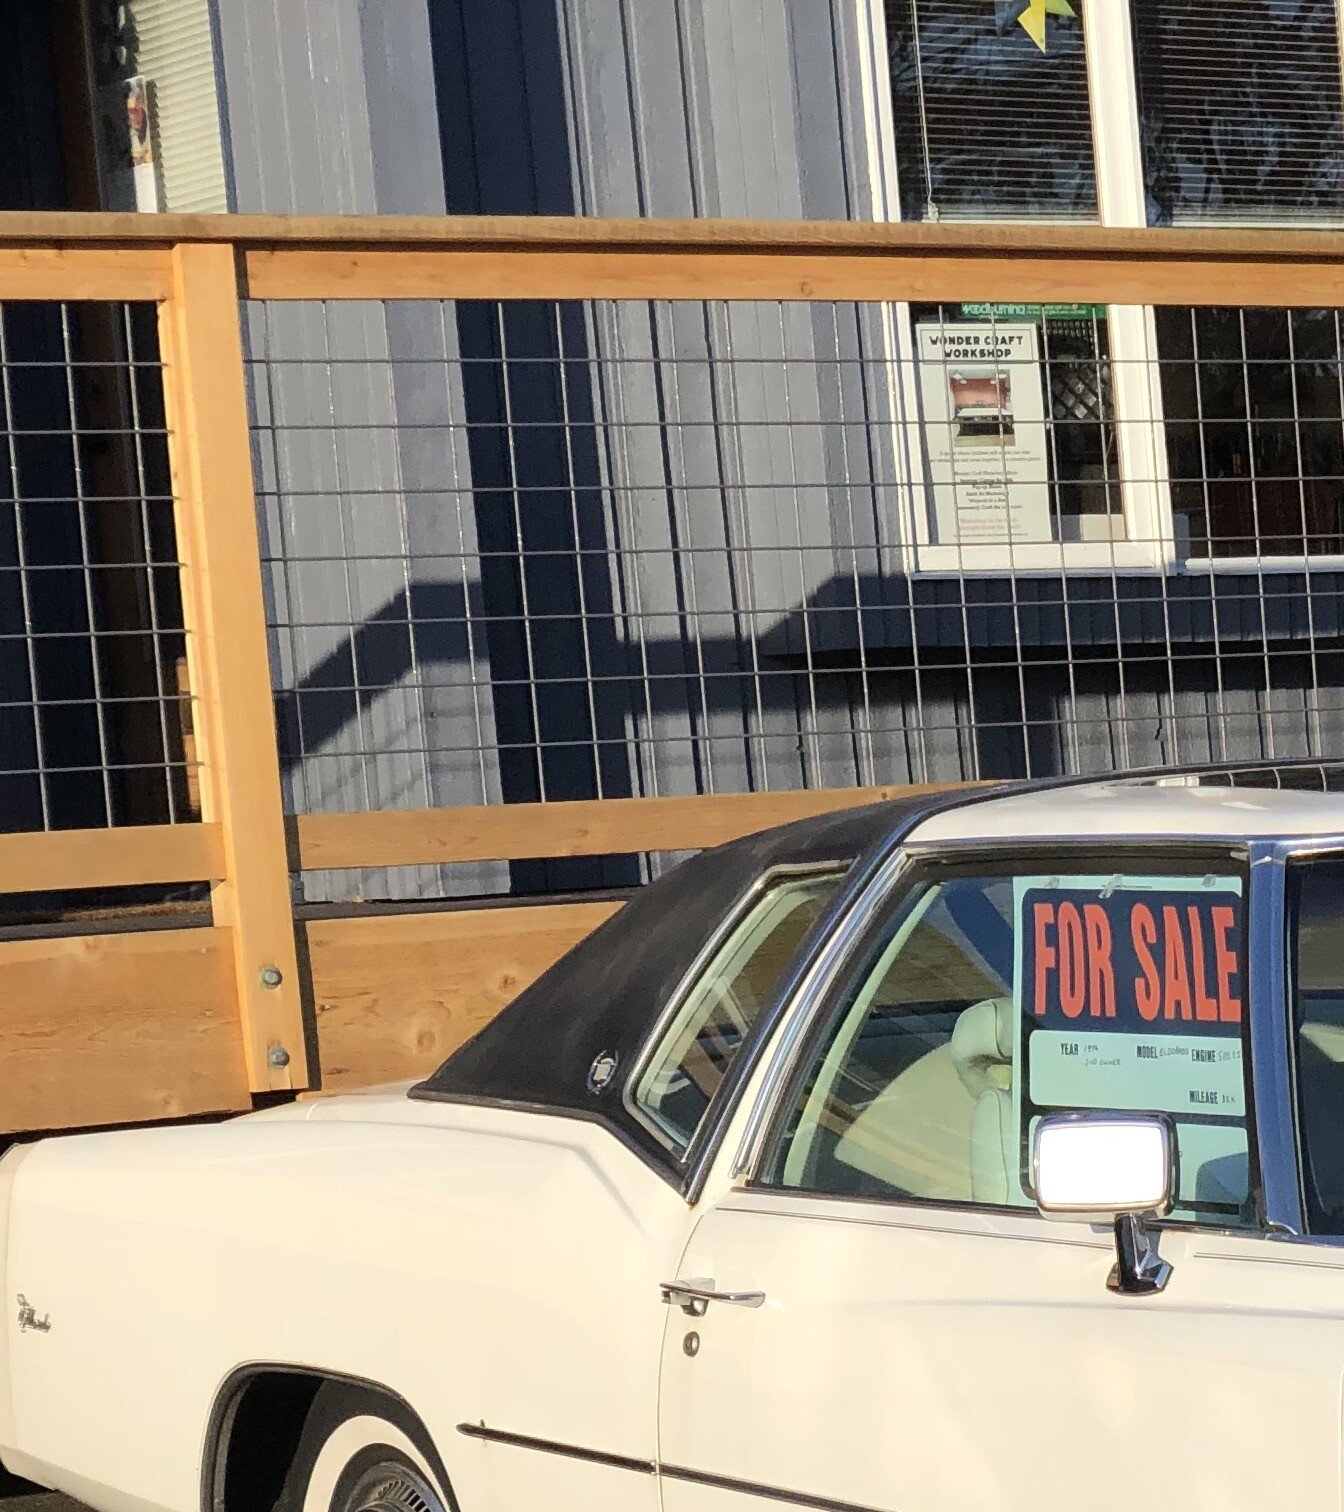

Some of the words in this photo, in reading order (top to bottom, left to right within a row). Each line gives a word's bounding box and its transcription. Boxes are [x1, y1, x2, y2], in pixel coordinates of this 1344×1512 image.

[929, 335, 980, 346] WONDER
[984, 335, 1023, 346] CRAFT
[944, 348, 1011, 358] WORKSHOP
[1033, 901, 1116, 1018] FOR
[1130, 902, 1242, 1022] SALE
[1060, 1042, 1079, 1056] YEAR
[1136, 1045, 1158, 1059] MODEL
[1191, 1048, 1216, 1063] ENGINE
[1189, 1090, 1218, 1104] MILEAGE
